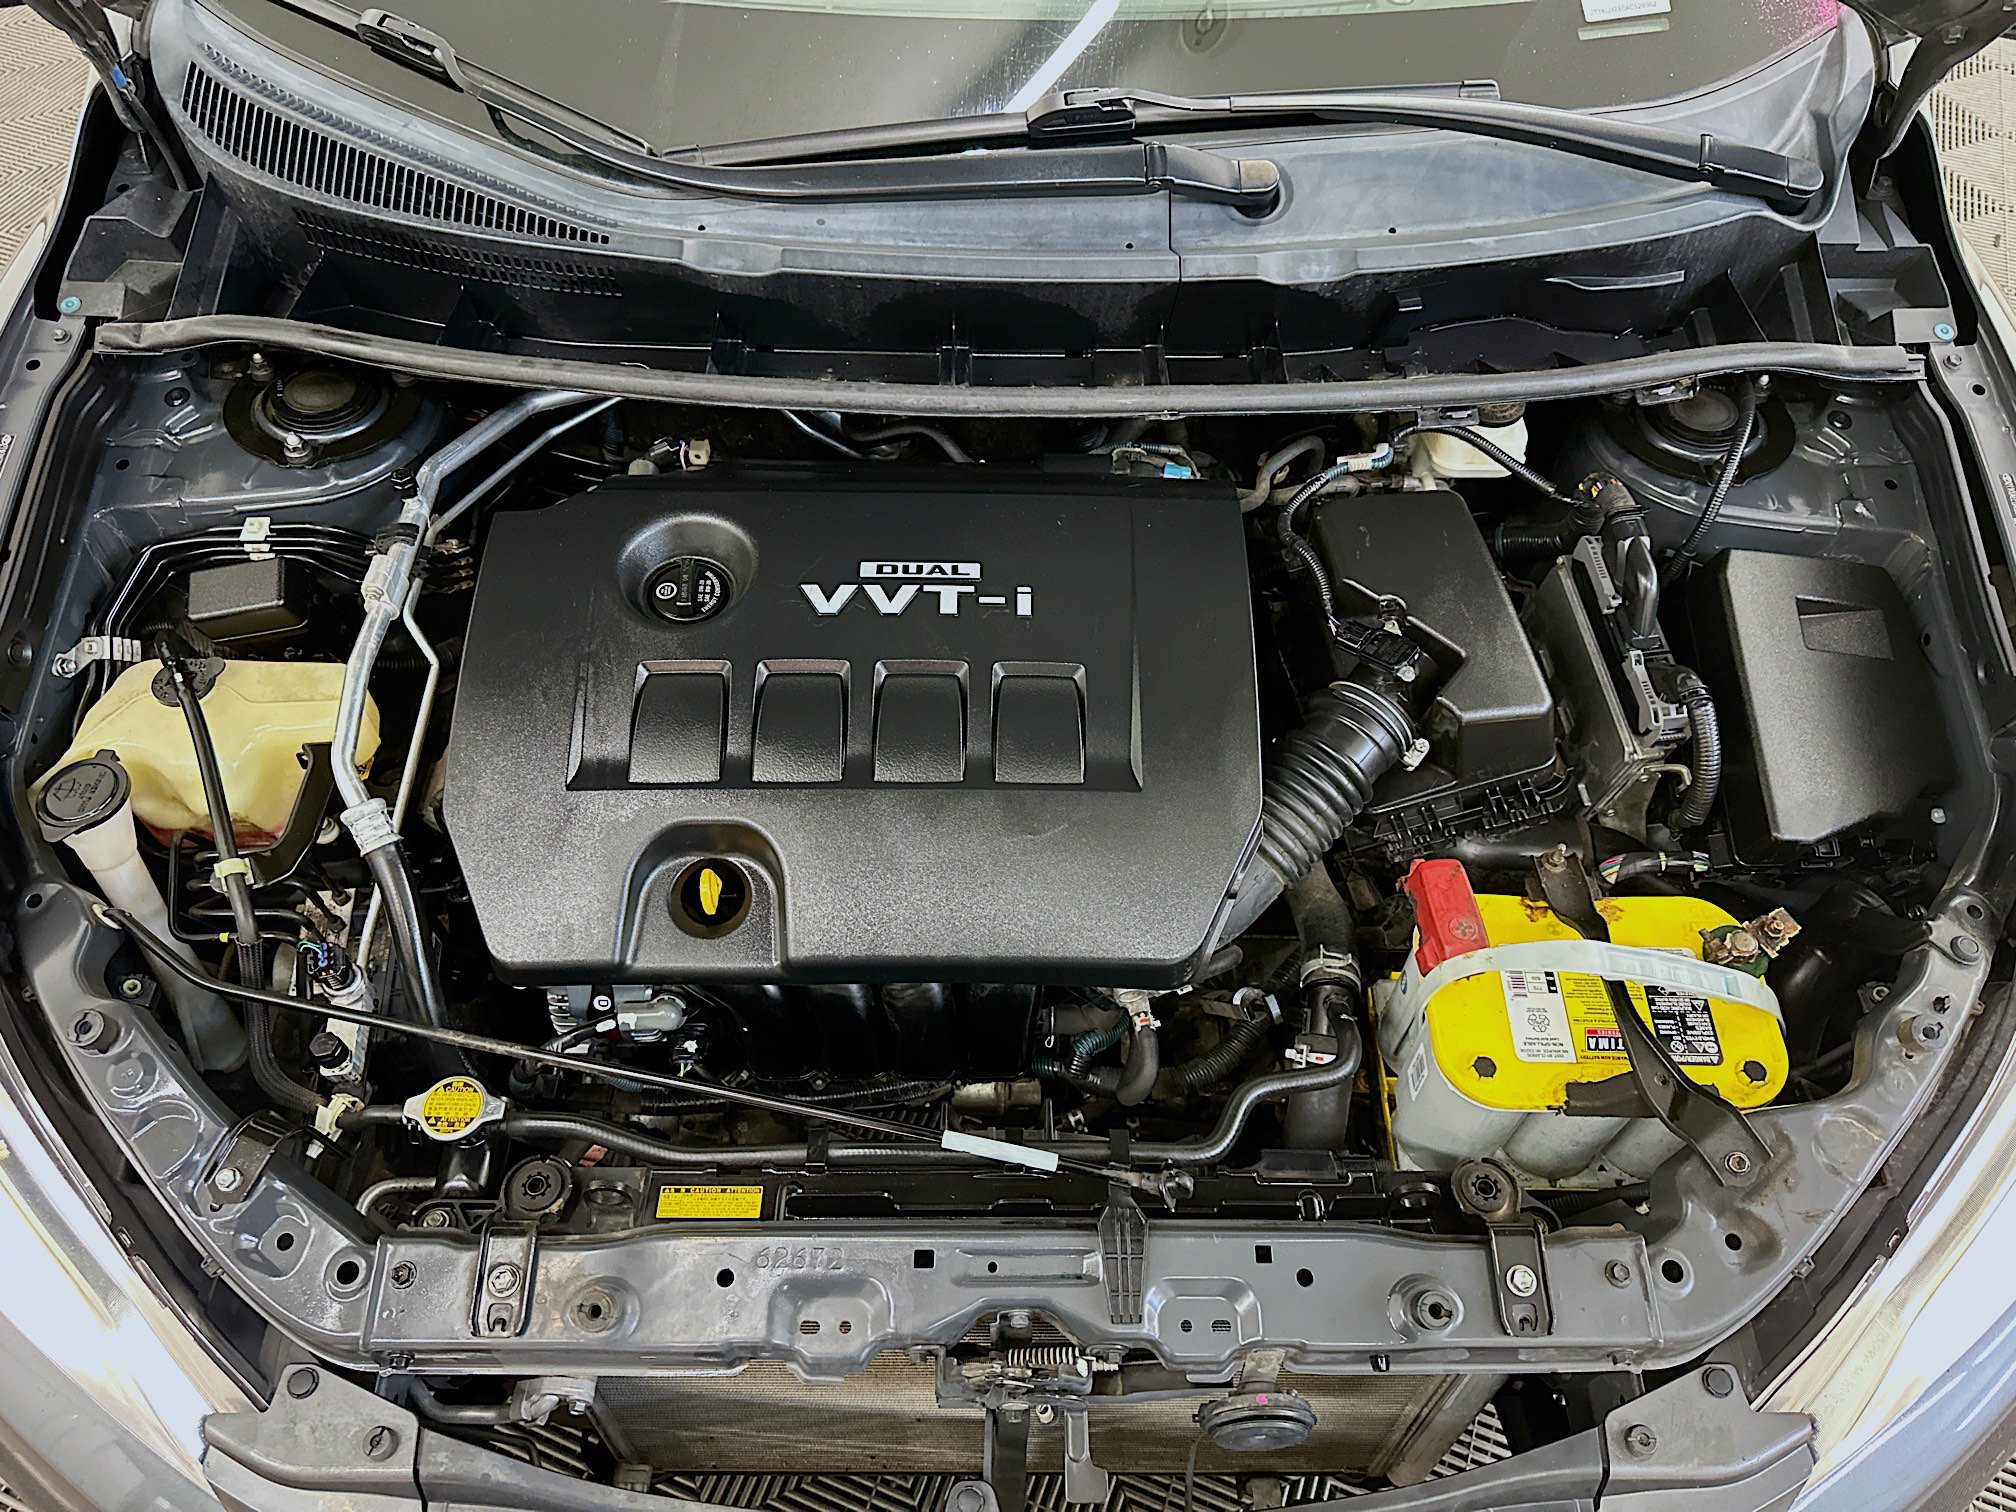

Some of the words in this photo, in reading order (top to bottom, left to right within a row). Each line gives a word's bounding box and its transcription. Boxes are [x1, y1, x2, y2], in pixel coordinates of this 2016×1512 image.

[876, 563, 971, 576] DUAL
[800, 584, 1033, 617] VVT-i
[1588, 1037, 1626, 1050] TIMA
[756, 1246, 844, 1270] 62672
